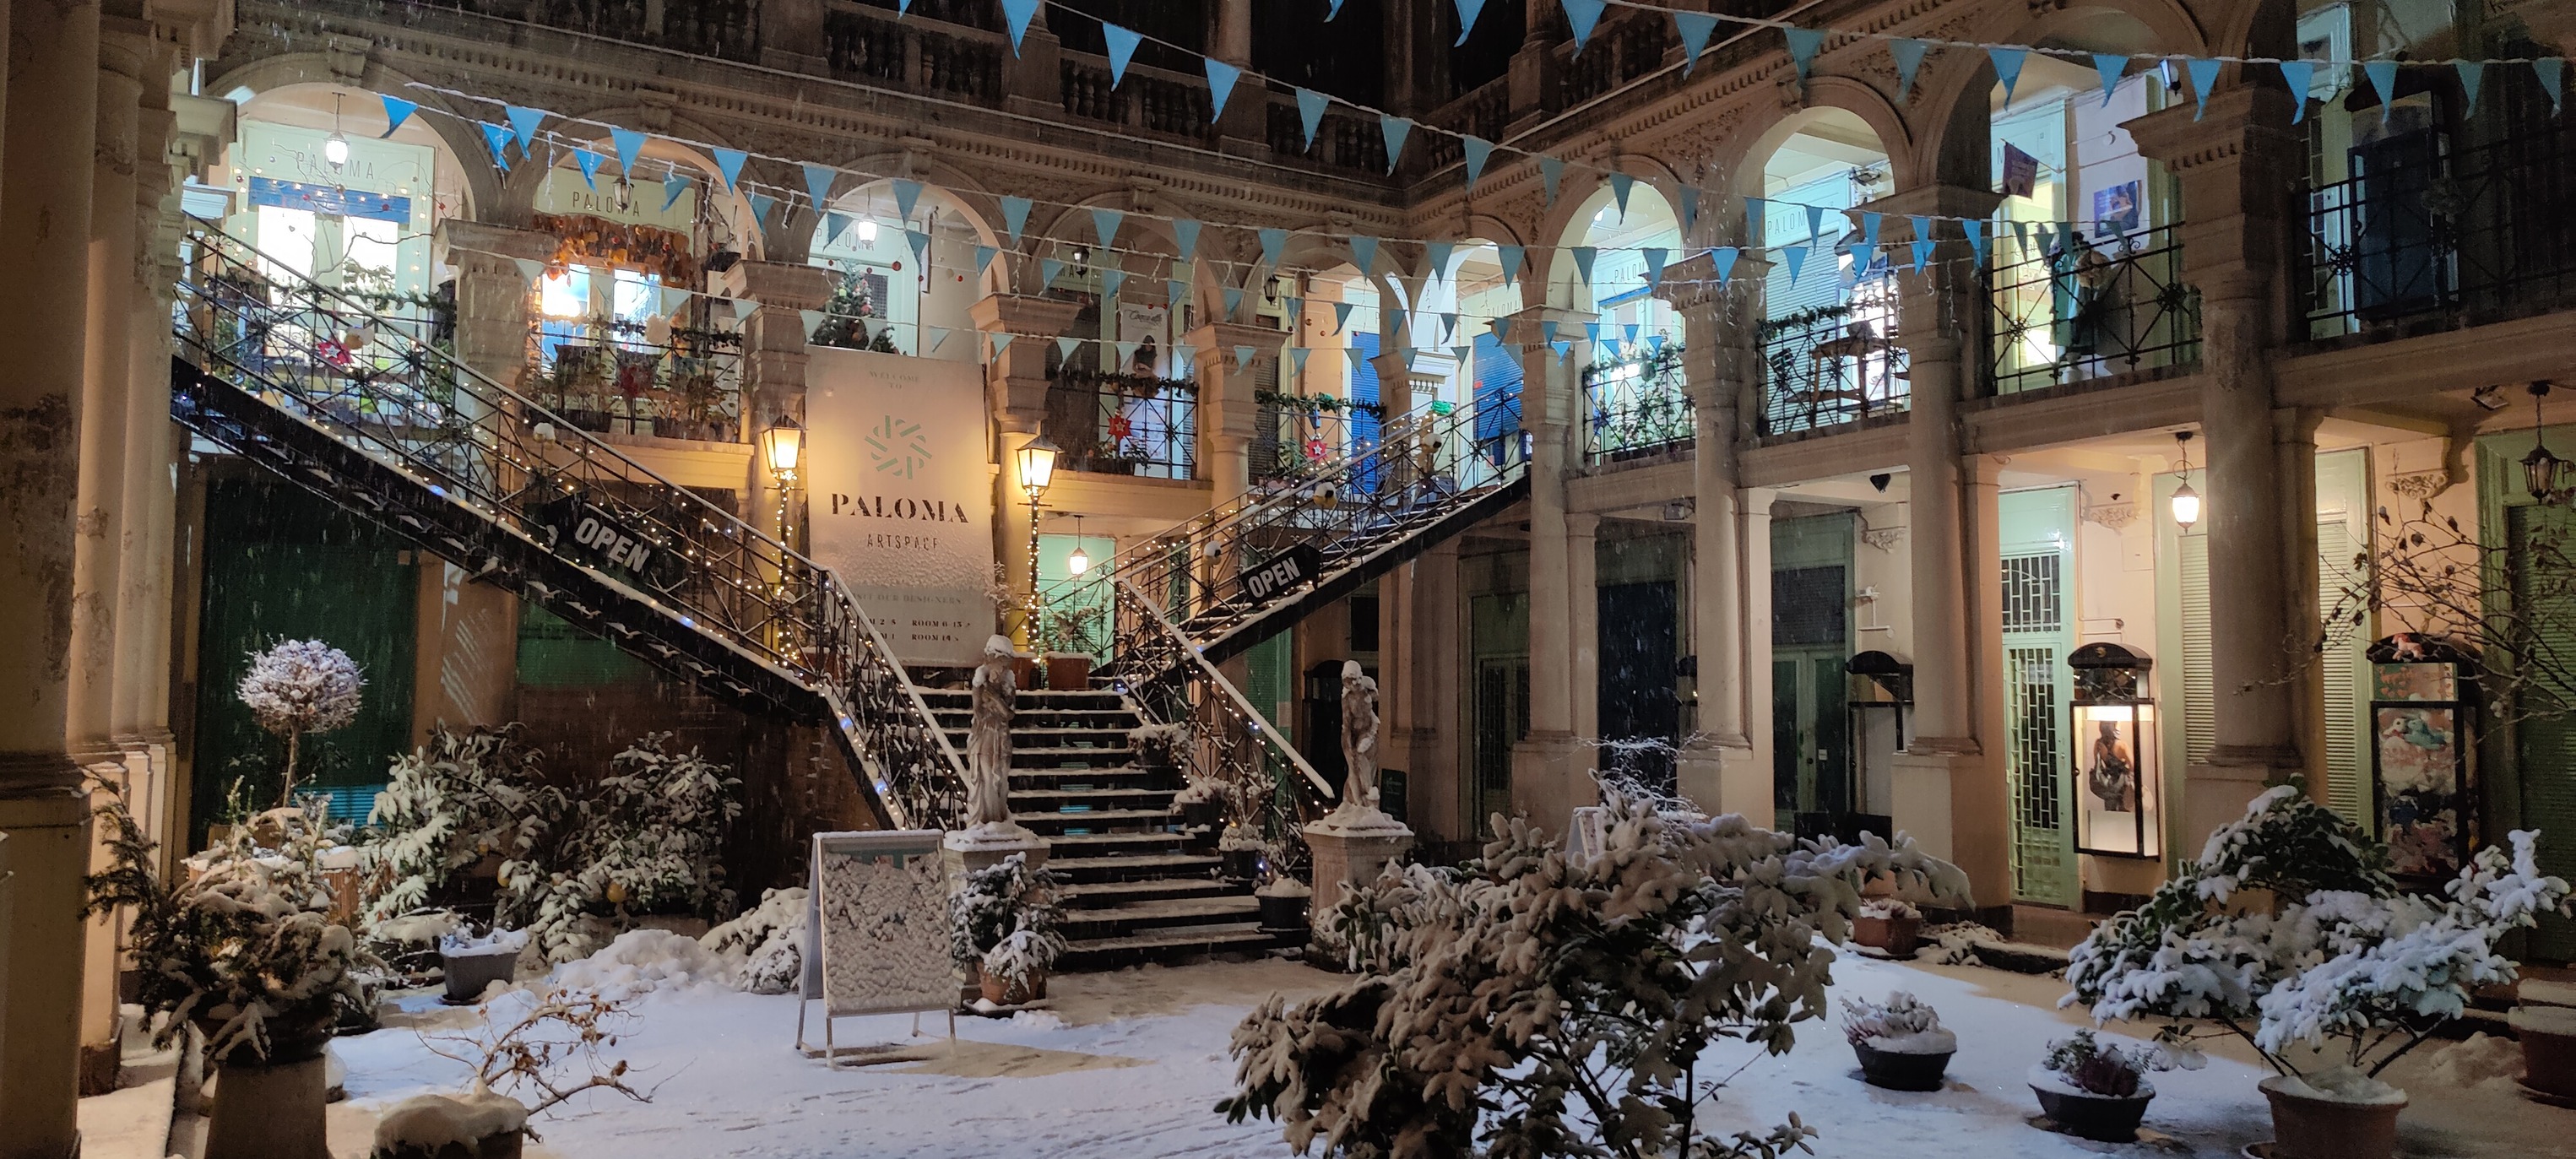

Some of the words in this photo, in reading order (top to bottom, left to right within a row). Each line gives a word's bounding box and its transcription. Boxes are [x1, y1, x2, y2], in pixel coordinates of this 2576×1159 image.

[572, 191, 640, 217] PALOA
[1767, 209, 1806, 237] PALOM
[1614, 261, 1646, 284] PALOM
[832, 492, 969, 523] PALOMA
[575, 517, 651, 573] OPEN
[1248, 556, 1301, 598] OPEN
